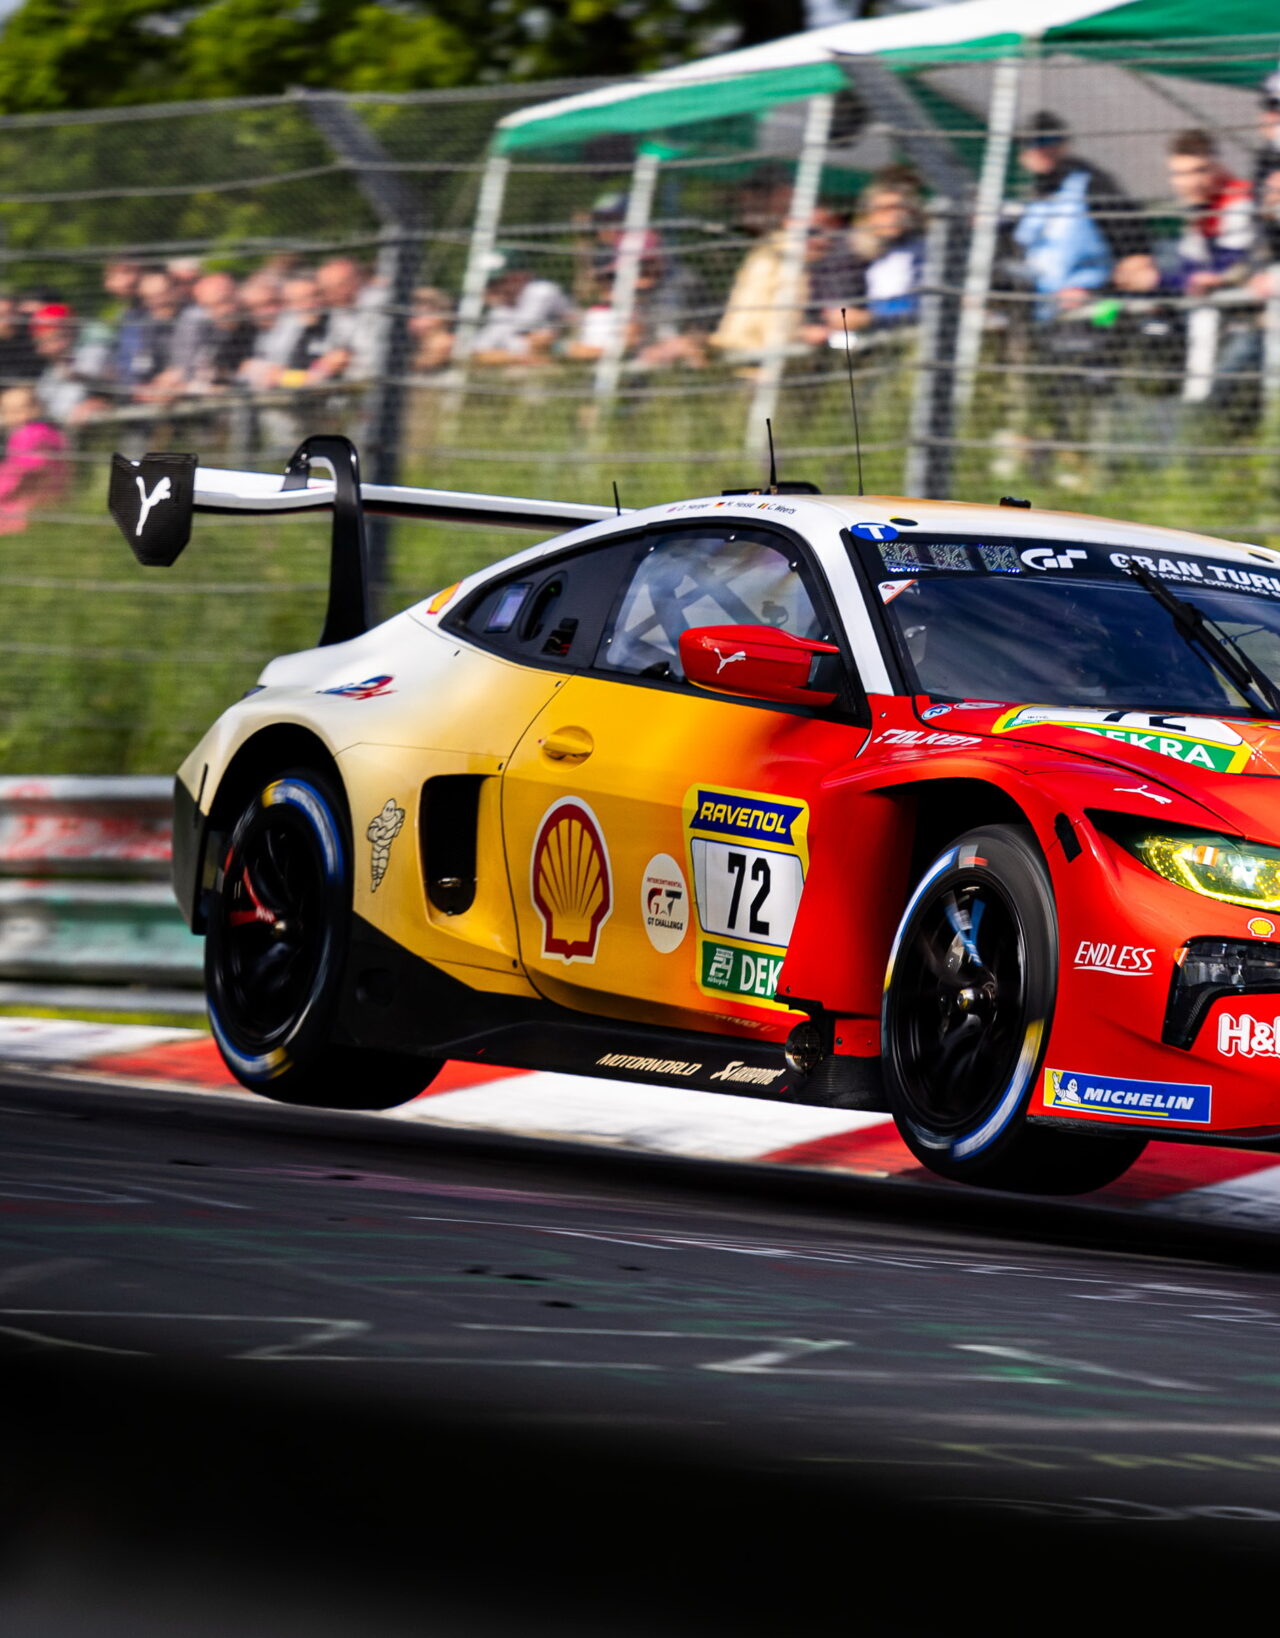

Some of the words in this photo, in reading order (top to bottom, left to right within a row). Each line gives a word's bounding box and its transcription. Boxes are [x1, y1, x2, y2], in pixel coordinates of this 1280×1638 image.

[858, 524, 886, 540] T
[873, 728, 982, 746] FALKEN
[700, 801, 787, 834] RAVENOL
[727, 852, 771, 936] 72
[655, 918, 684, 931] CHALLENGE
[1073, 941, 1156, 971] ENDLESS
[595, 1053, 702, 1076] MOTORWORLD
[1083, 1086, 1194, 1110] MICHELIN
